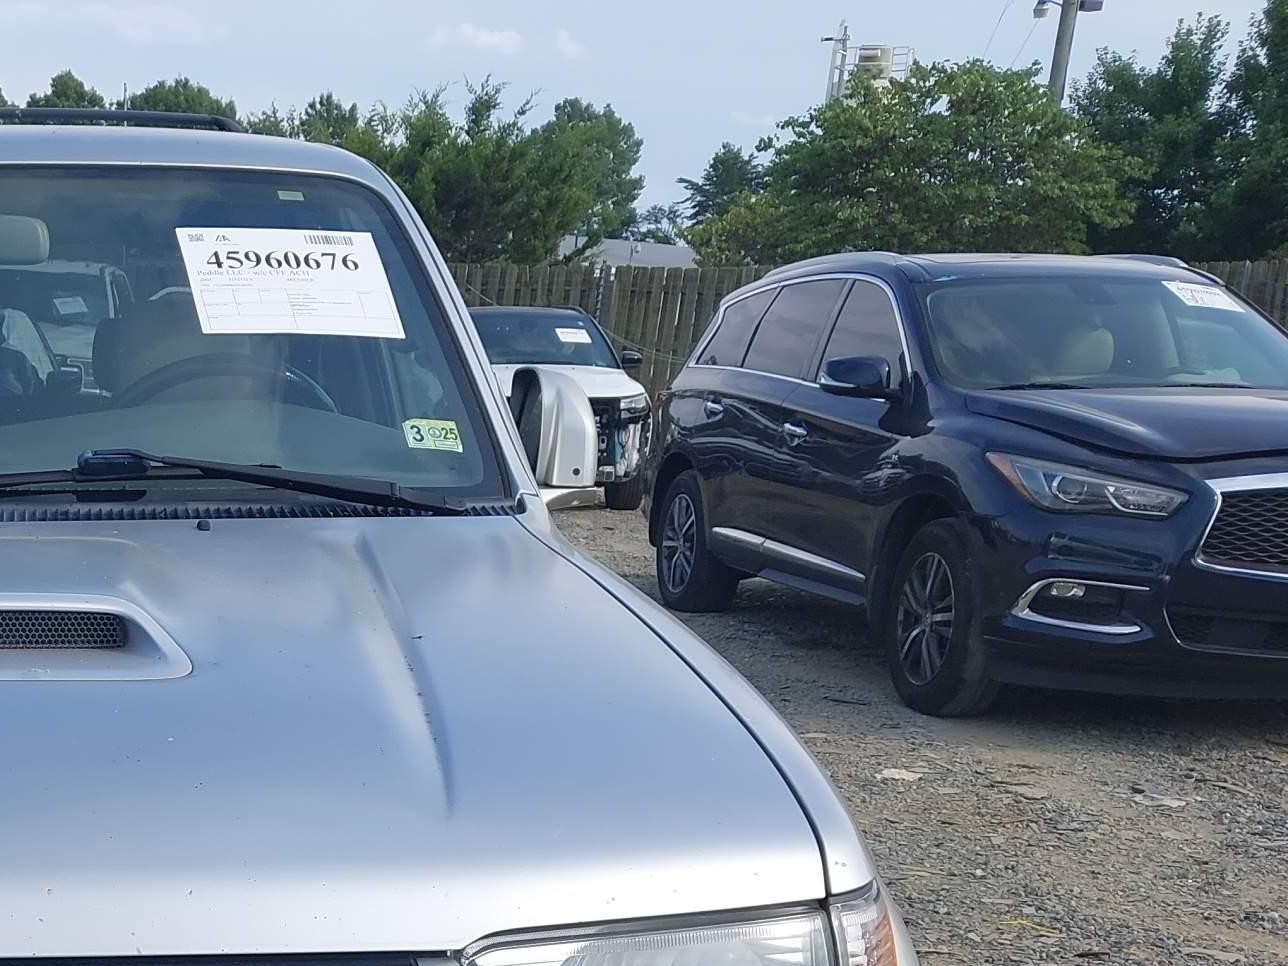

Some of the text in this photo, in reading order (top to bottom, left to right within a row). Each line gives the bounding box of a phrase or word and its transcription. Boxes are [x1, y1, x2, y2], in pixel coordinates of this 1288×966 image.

[206, 250, 359, 271] 45960676
[410, 425, 458, 442] 3 25
